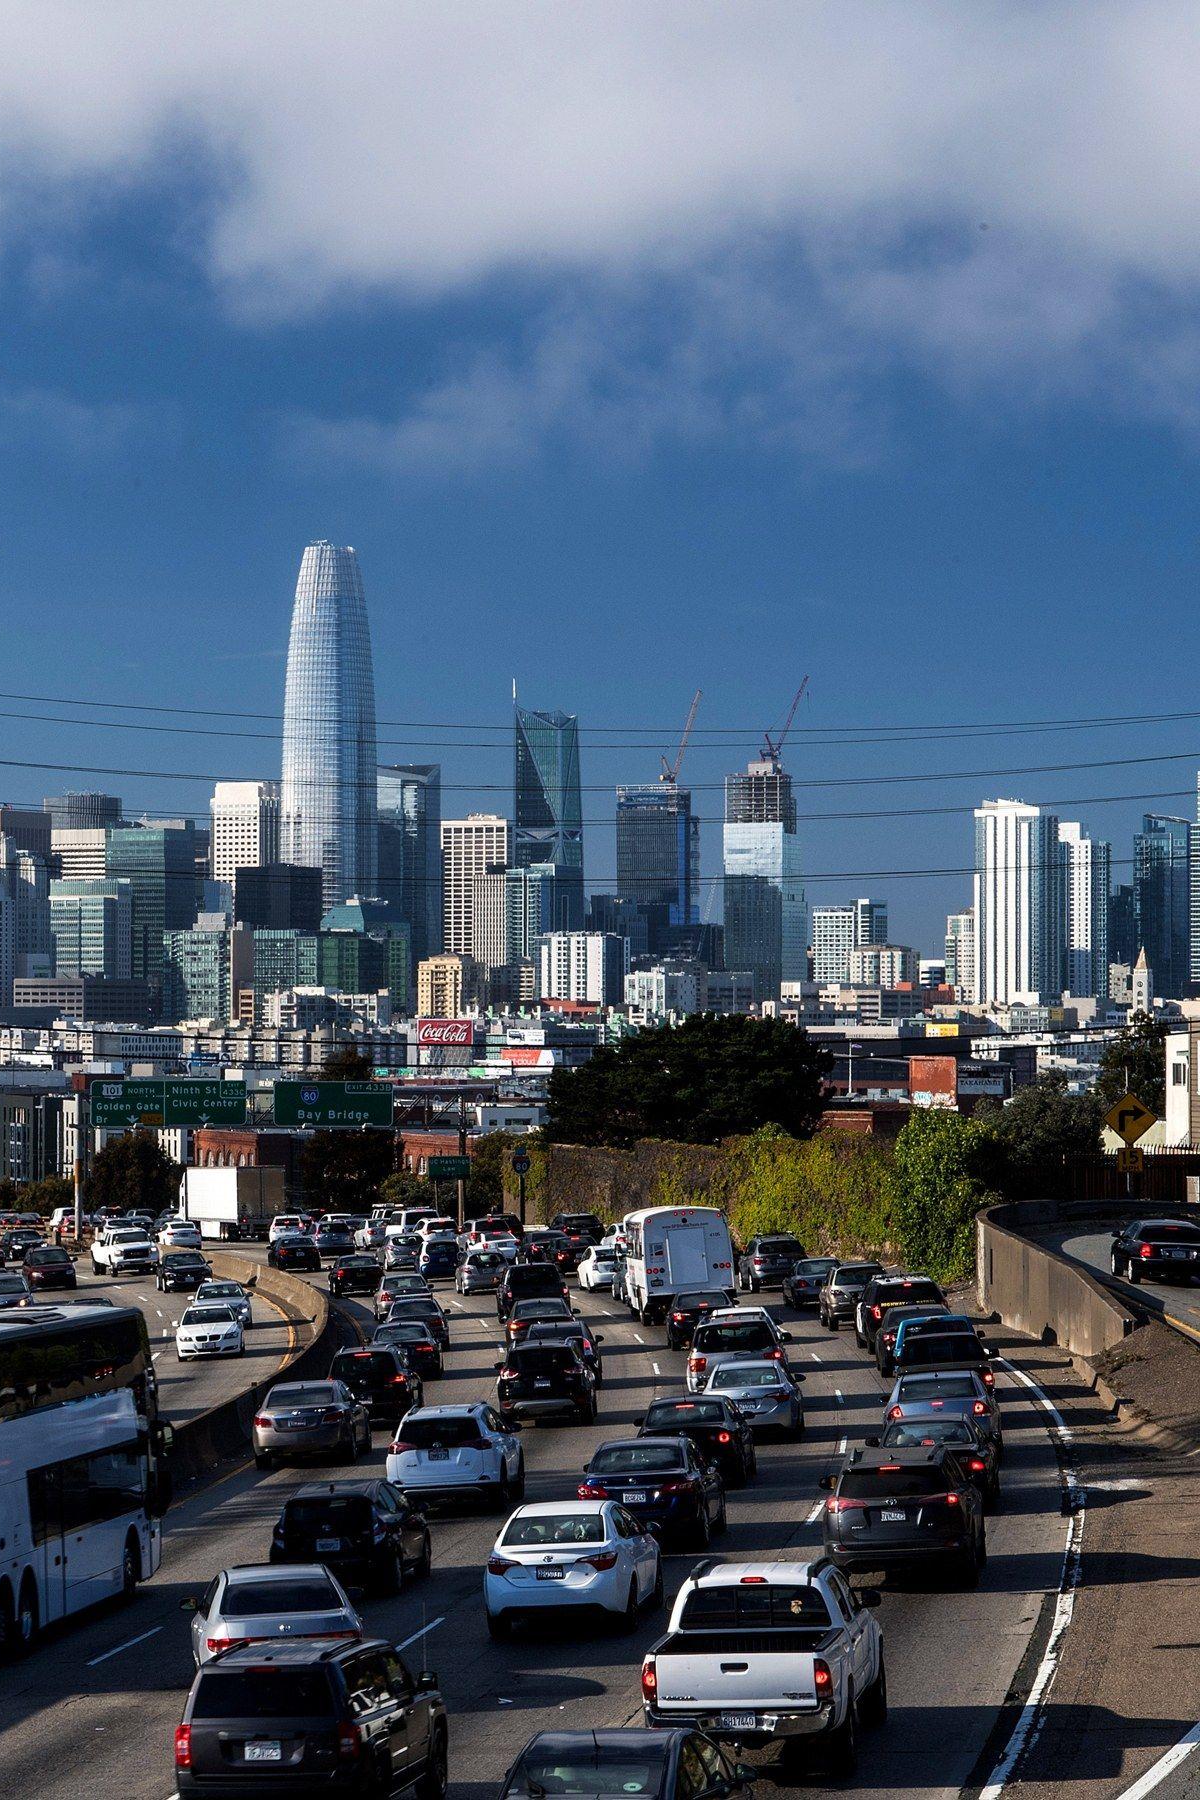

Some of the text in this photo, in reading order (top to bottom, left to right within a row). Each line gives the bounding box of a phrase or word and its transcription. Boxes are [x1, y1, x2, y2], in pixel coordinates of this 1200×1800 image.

[420, 1022, 470, 1042] Coca-Cola
[106, 1087, 120, 1095] 101
[172, 1086, 216, 1095] Ninth St
[366, 1082, 392, 1092] 433B
[303, 1092, 316, 1100] 80
[97, 1103, 160, 1111] Golden Gate
[203, 1100, 238, 1108] Center
[298, 1110, 370, 1121] Bay Bridge
[1122, 1150, 1139, 1164] 15
